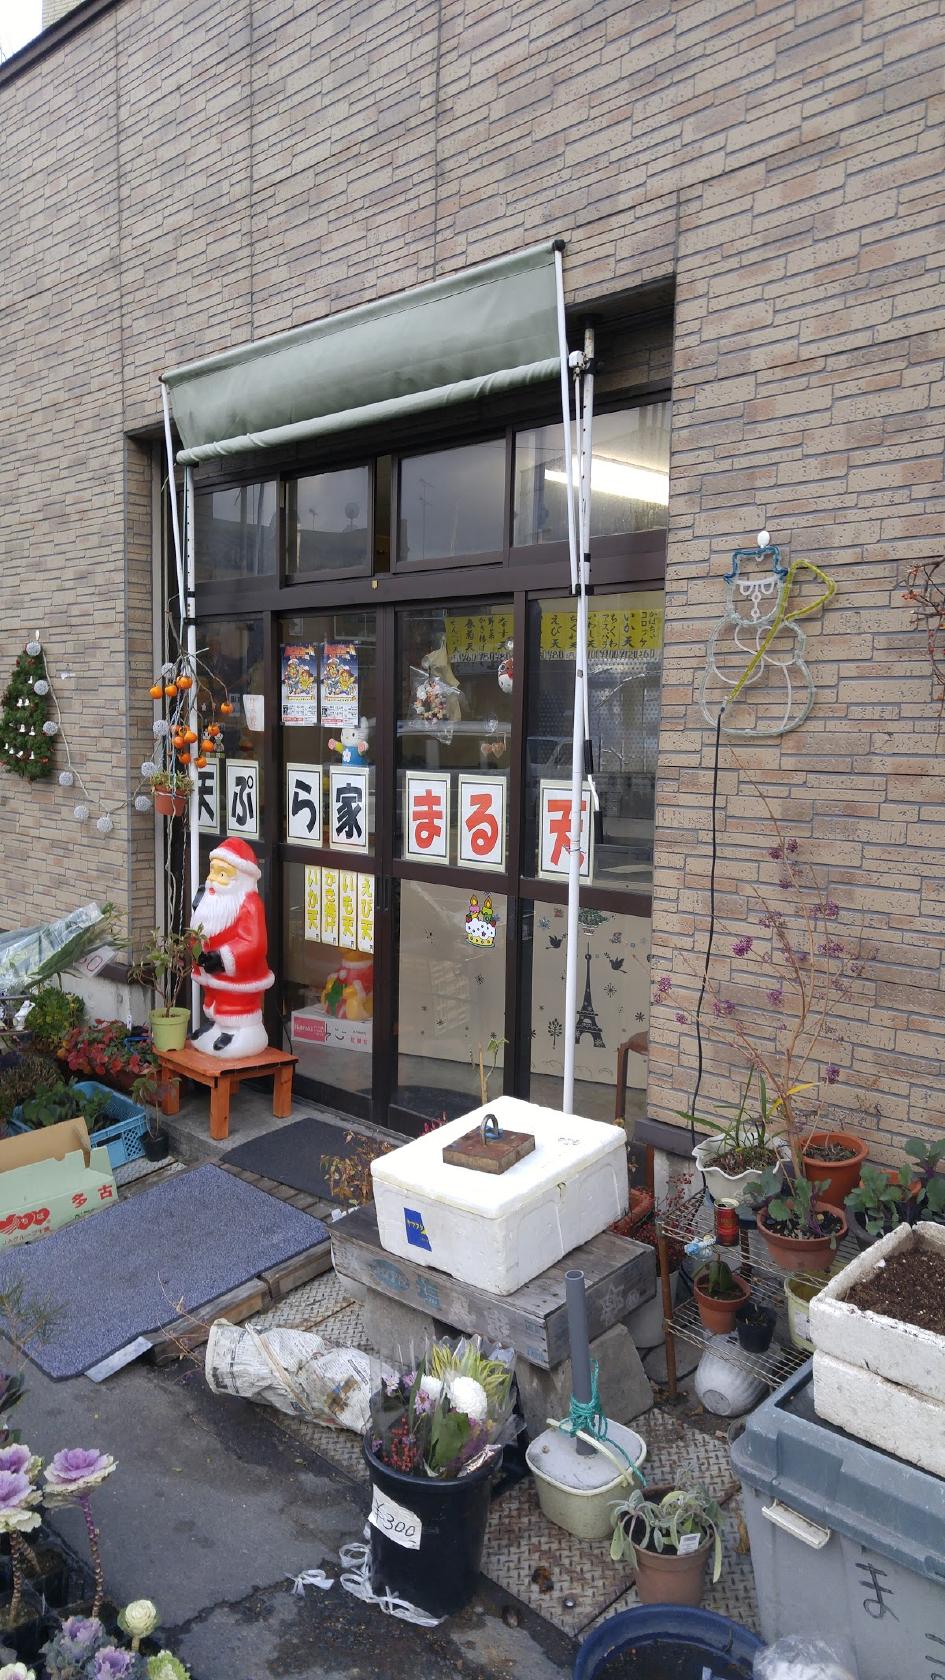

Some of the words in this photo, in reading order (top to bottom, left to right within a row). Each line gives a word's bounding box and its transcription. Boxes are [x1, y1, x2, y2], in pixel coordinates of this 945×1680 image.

[307, 865, 319, 930] いか天
[341, 873, 354, 938] いも天
[360, 874, 374, 941] えび天
[71, 1183, 113, 1209] 多古
